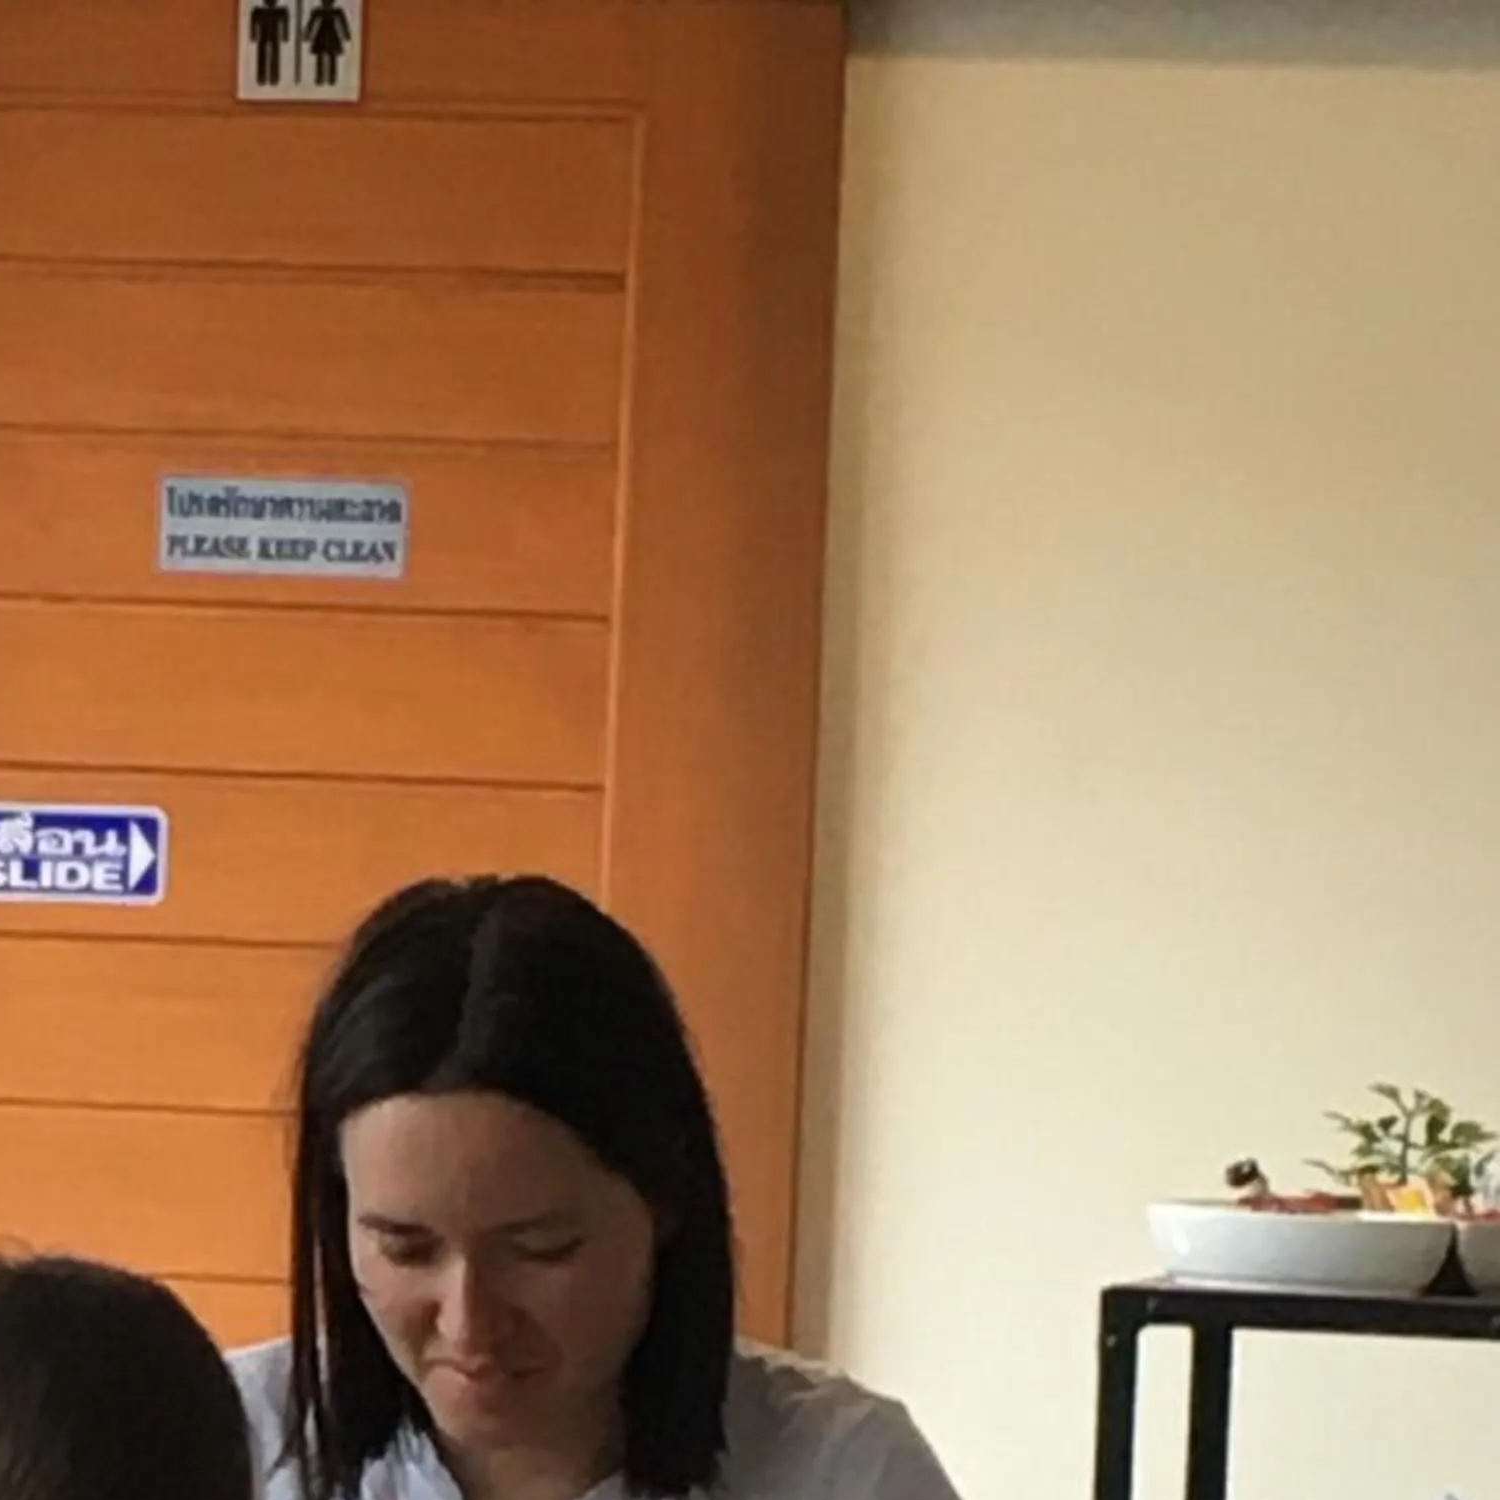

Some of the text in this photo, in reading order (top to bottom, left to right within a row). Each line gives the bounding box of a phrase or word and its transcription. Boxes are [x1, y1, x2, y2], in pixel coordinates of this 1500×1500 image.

[166, 534, 397, 563] PLEASE KEEP CLEAN
